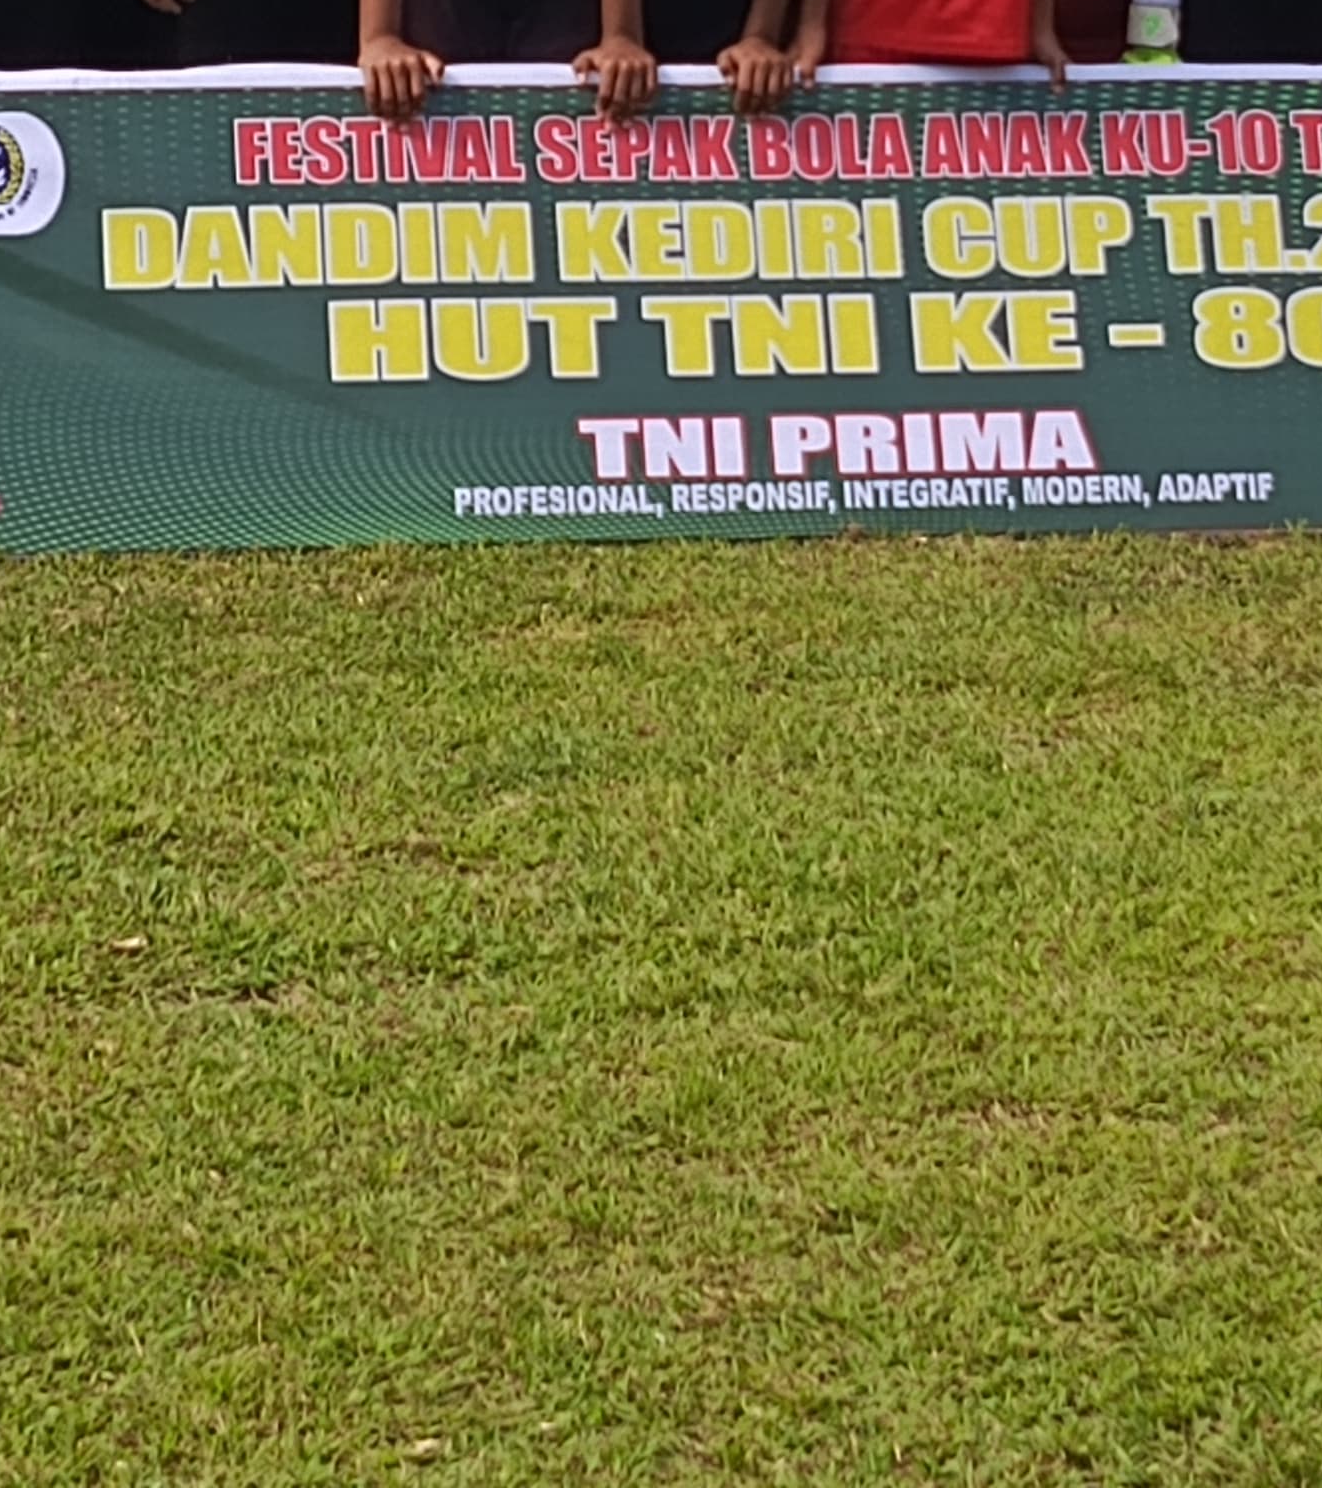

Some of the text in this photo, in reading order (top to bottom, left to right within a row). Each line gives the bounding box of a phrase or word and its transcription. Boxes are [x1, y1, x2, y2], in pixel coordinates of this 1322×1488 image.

[234, 114, 526, 185] FESTIVAL
[535, 114, 739, 184] SEPAK
[747, 113, 914, 182] BOLA
[921, 112, 1098, 179] ANAK
[1101, 110, 1285, 178] KU-10
[101, 201, 535, 290] DANDIM
[556, 198, 905, 283] KEDIRI
[923, 196, 1132, 279] CUP
[328, 296, 617, 382] HUT
[641, 292, 880, 378] TNI
[910, 290, 1084, 373] KE
[578, 410, 1096, 479] TNI PRIMA
[453, 472, 1275, 518] PROFESIONAL, RESPONSIF, INTEGRATIF, MODERN, ADAPTIF
